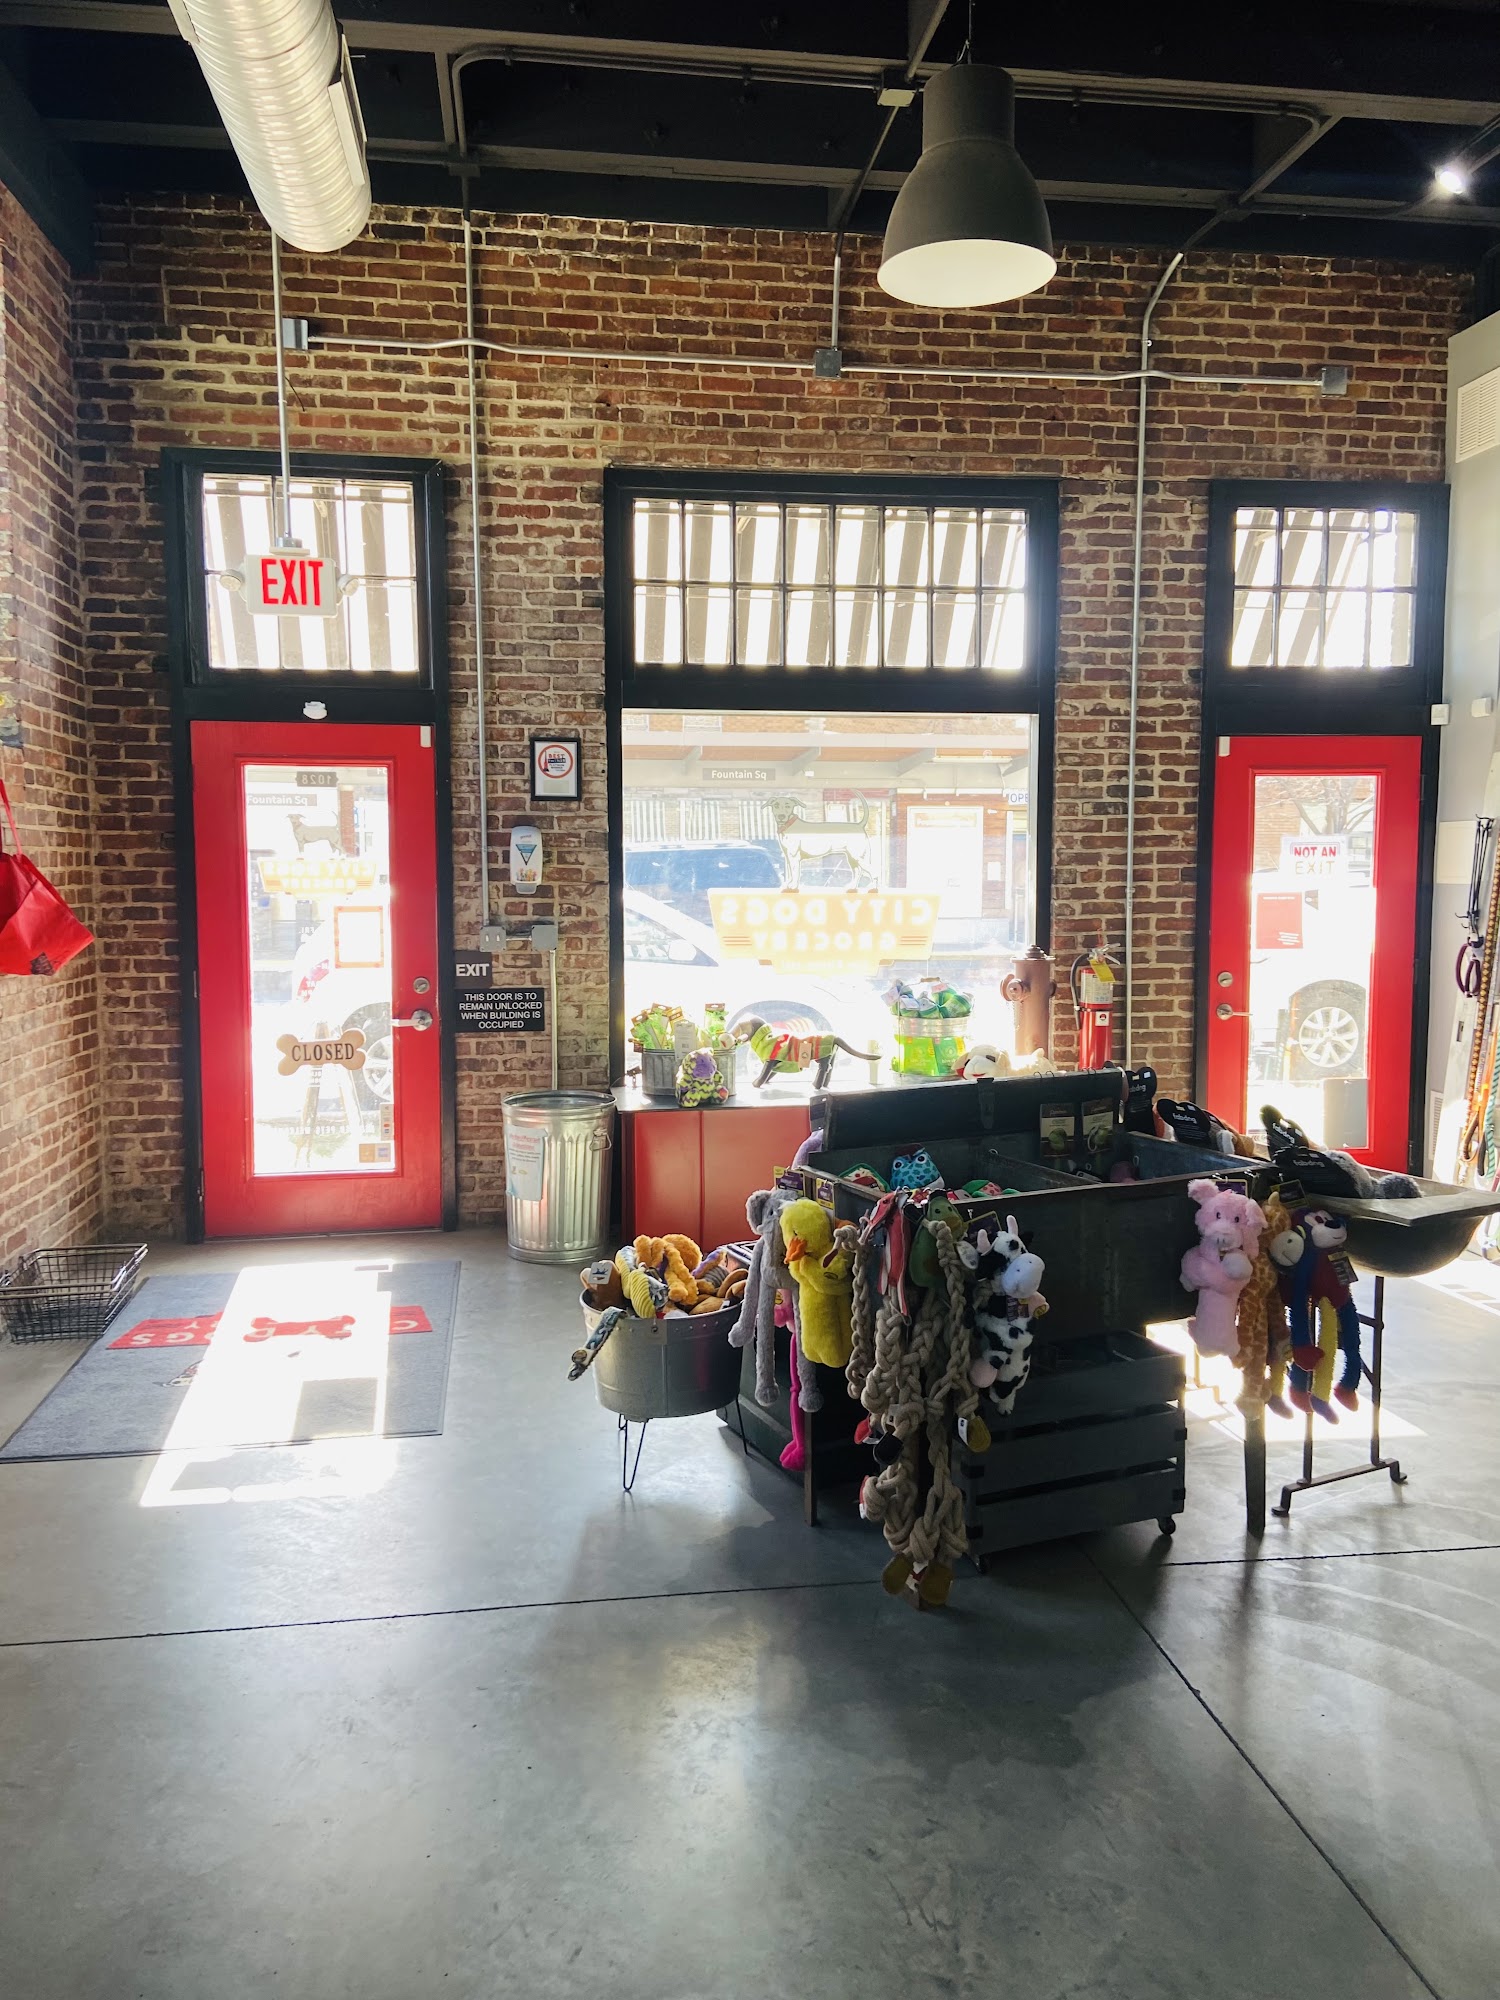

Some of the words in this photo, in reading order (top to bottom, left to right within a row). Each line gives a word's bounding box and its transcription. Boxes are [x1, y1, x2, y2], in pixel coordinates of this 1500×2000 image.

[261, 558, 324, 607] EXIT
[711, 770, 753, 779] Fountain
[754, 770, 767, 781] Sq
[247, 795, 292, 805] Fountain
[294, 796, 308, 807] Sq
[1010, 793, 1028, 803] OPE
[1293, 846, 1318, 858] NOT
[1321, 846, 1337, 857] AN
[1295, 861, 1335, 875] EXIT
[455, 963, 490, 977] EXIT
[464, 993, 485, 1001] THIS
[486, 993, 513, 1001] DOOR
[514, 992, 523, 1000] IS
[525, 992, 537, 1000] TO
[459, 1002, 493, 1011] REMAIN
[494, 1001, 543, 1010] UNLOCKED
[461, 1012, 488, 1020] WHEN
[489, 1011, 531, 1019] BUILDING
[532, 1010, 541, 1018] IS
[478, 1020, 525, 1029] OCCUPIED
[291, 1043, 355, 1062] CLOSED
